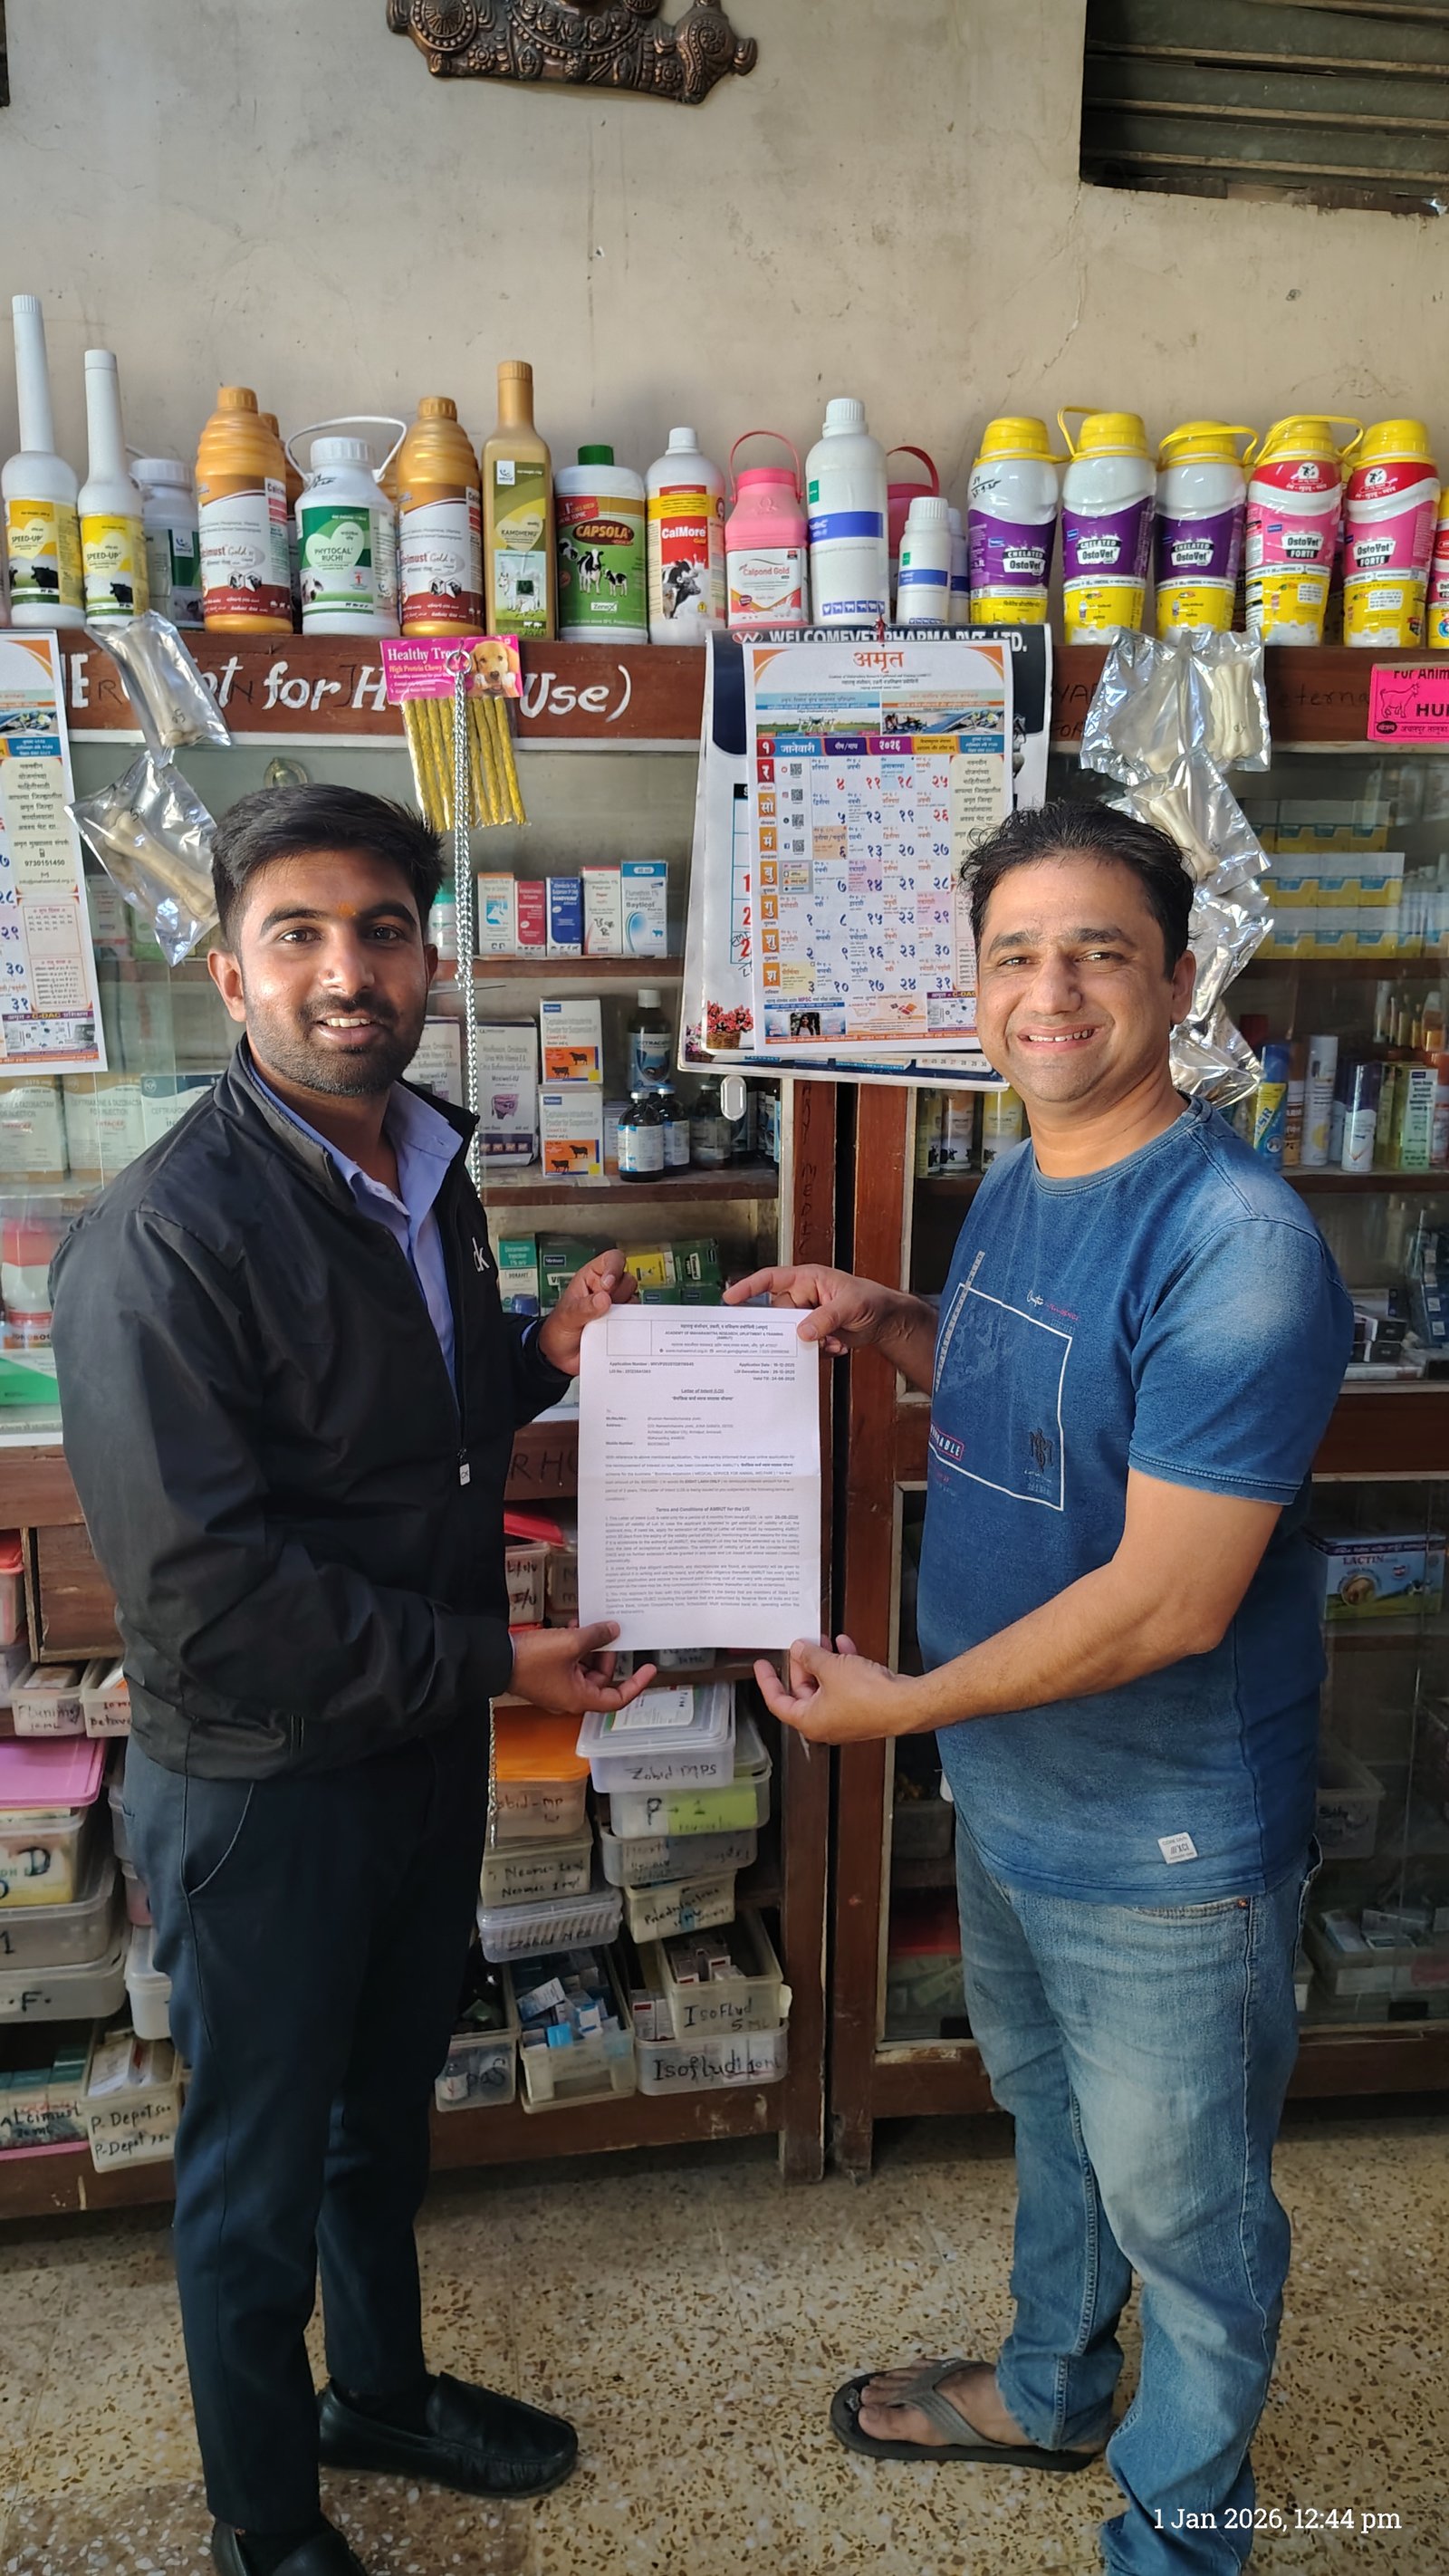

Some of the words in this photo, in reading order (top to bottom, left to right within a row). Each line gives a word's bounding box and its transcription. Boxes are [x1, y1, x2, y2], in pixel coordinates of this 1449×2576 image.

[576, 524, 629, 539] CAPSOLA
[661, 526, 705, 540] CalMore
[12, 535, 43, 543] SPEED-UP
[1080, 539, 1117, 549] CHELATED
[1288, 536, 1319, 546] OstoVet
[227, 544, 248, 558] Gold
[314, 547, 351, 555] PHYTOCAL
[1007, 549, 1043, 558] CHELATED
[1175, 543, 1210, 552] CHELATED
[1357, 544, 1390, 556] OstoVet
[86, 552, 120, 561] SPEED-UP
[429, 553, 449, 563] Gold
[1081, 548, 1114, 560] OstoVet
[1176, 551, 1207, 562] OstoVet
[1290, 550, 1315, 558] FORTE
[1009, 560, 1041, 571] OstoVet
[1359, 556, 1386, 566] FORTE
[773, 566, 790, 575] Gold
[388, 647, 429, 665] Healthy
[852, 651, 904, 673] अमृत
[389, 666, 403, 675] High
[404, 664, 424, 673] Protein
[425, 664, 443, 674] Chewy
[263, 662, 341, 713] for
[519, 664, 632, 723] Use)
[781, 742, 815, 755] जानेवारी
[878, 739, 901, 753] २०२६
[836, 777, 845, 791] ४
[866, 776, 881, 790] ११
[897, 775, 913, 789] १८
[932, 775, 948, 789] २५
[838, 812, 846, 824] ५
[866, 811, 882, 824] १२
[898, 810, 915, 823] १९
[933, 809, 949, 824] २६
[840, 845, 847, 860] ६
[867, 844, 883, 859] १३
[898, 843, 915, 857] २०
[933, 843, 950, 856] २७
[838, 880, 847, 893] ७
[867, 879, 883, 892] १४
[898, 878, 916, 891] २१
[933, 877, 949, 890] २८
[626, 901, 655, 910] Bayticol
[806, 913, 813, 927] १
[840, 913, 848, 927] ८
[867, 912, 883, 926] १५
[898, 911, 915, 925] २२
[934, 910, 950, 924] २९
[1, 926, 19, 940] २९
[806, 947, 814, 960] २
[841, 947, 849, 960] ९
[868, 946, 885, 960] १६
[899, 945, 916, 958] २३
[934, 944, 950, 956] ३०
[5, 961, 24, 976] ३०
[808, 981, 815, 995] ३
[834, 981, 849, 994] १०
[868, 979, 885, 993] १७
[899, 977, 916, 991] २४
[936, 976, 951, 991] ३१
[11, 997, 29, 1014] ३१
[1343, 1554, 1385, 1566] LACTIN
